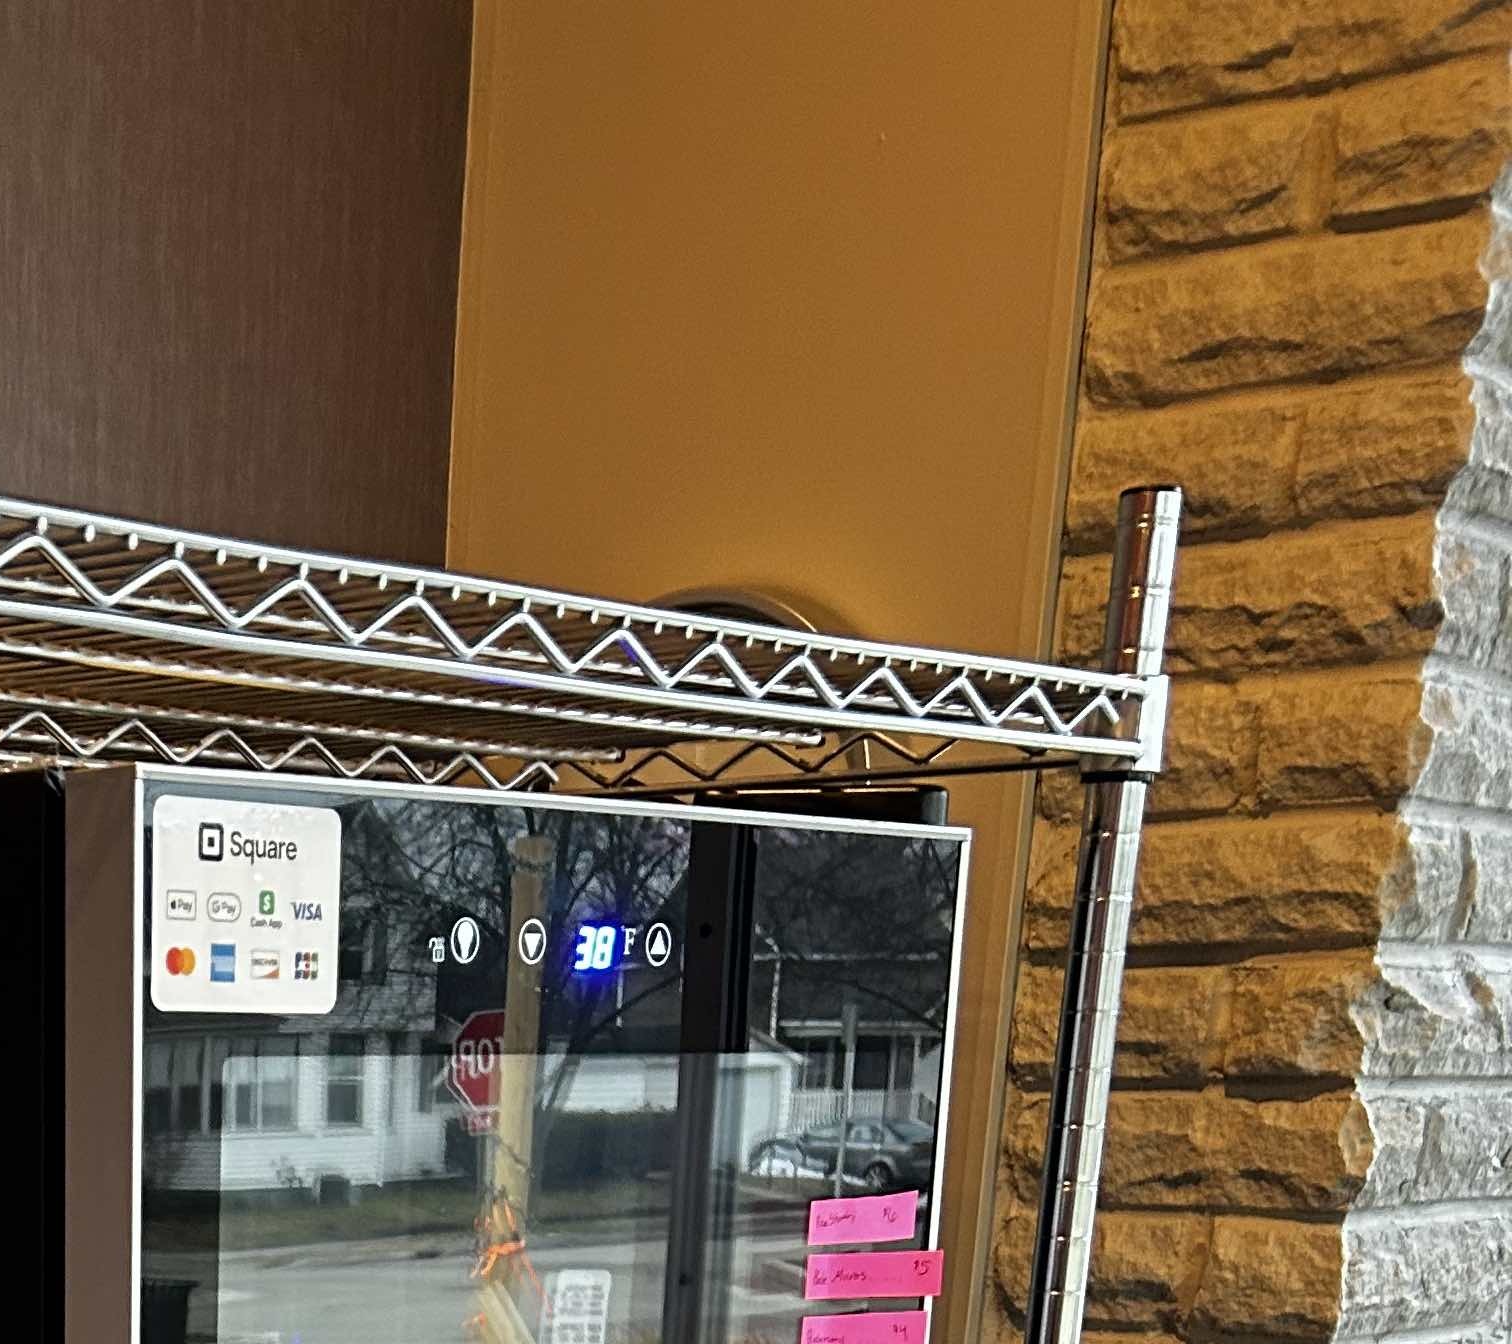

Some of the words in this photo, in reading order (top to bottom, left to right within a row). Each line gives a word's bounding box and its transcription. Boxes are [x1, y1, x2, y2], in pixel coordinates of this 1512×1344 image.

[230, 831, 297, 864] Square
[290, 900, 323, 921] VISA
[574, 925, 616, 971] 38
